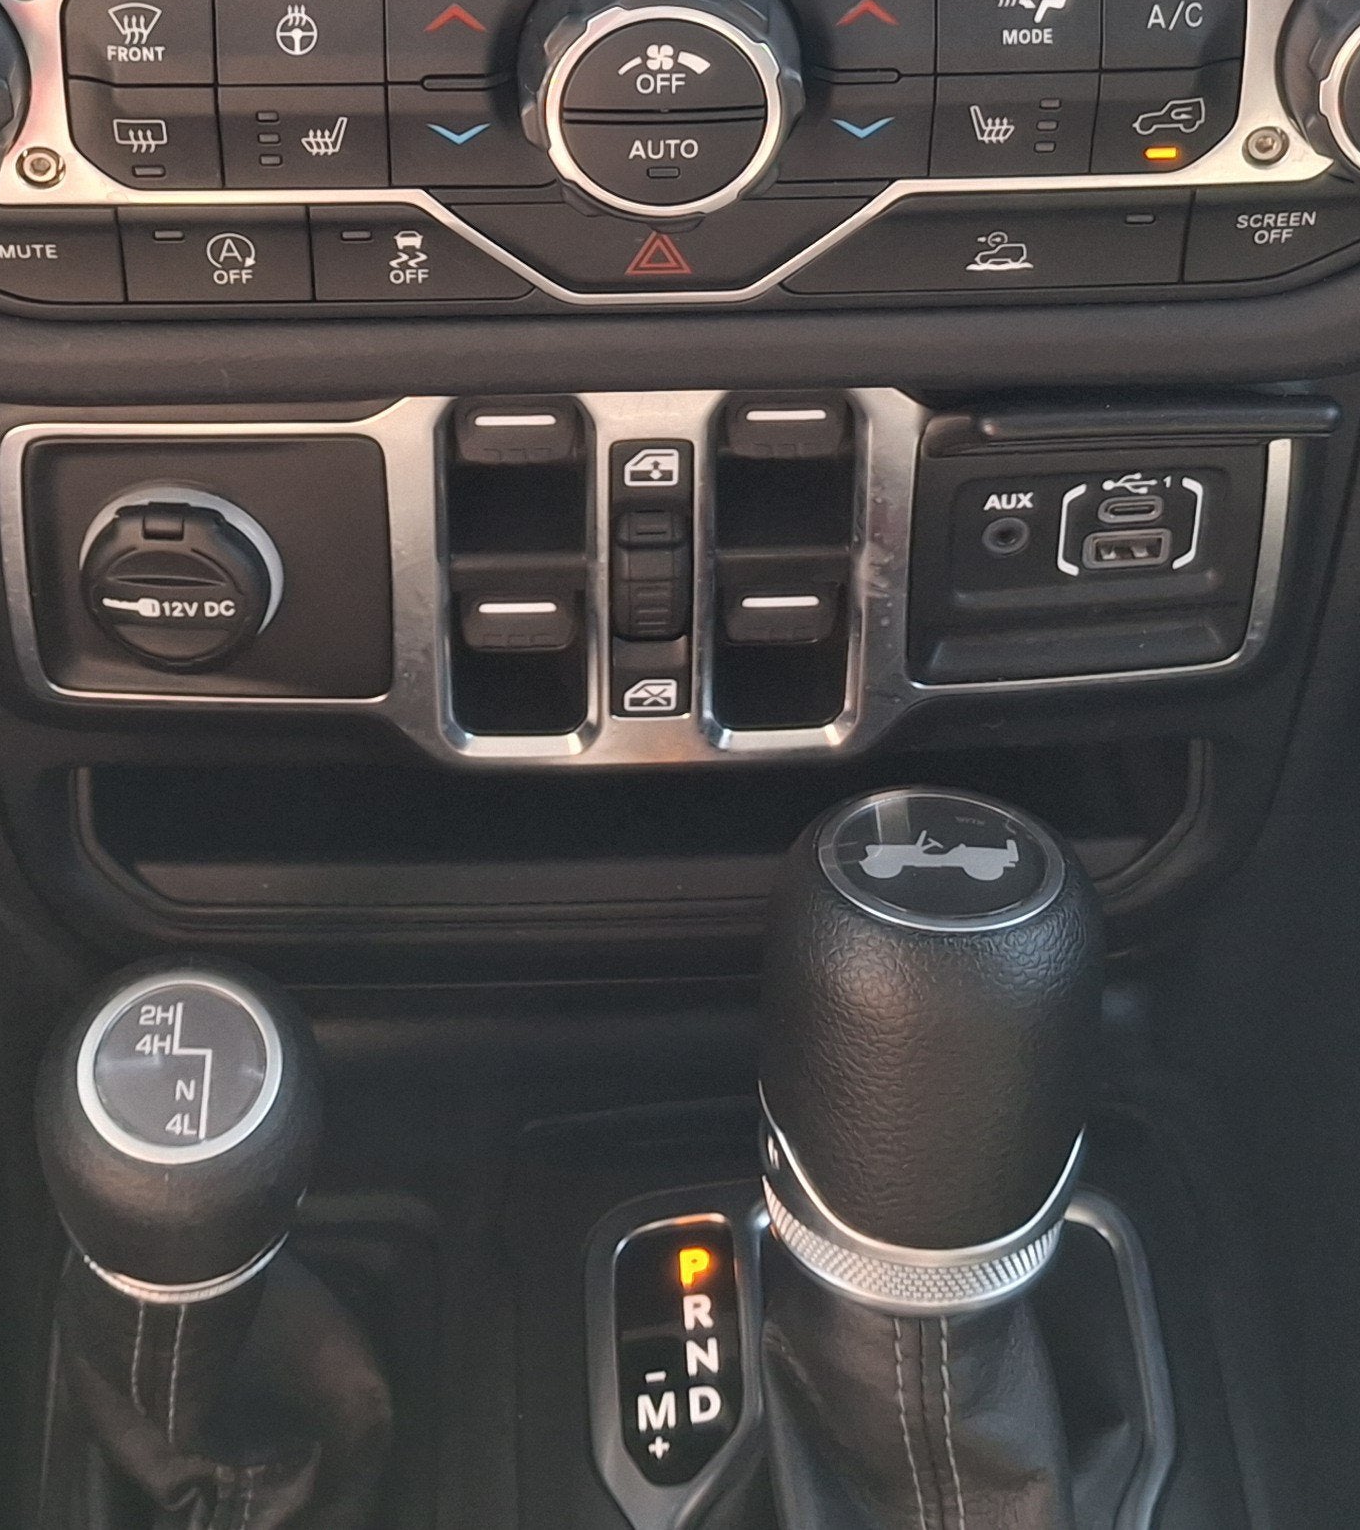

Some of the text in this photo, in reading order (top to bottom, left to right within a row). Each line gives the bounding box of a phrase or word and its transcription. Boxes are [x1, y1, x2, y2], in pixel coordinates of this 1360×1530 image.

[1147, 2, 1203, 29] A/C
[1002, 29, 1053, 45] MODE
[107, 45, 165, 63] FRONT
[636, 74, 686, 95] OFF
[628, 139, 699, 159] AUTO
[1237, 211, 1316, 228] SCREEN
[1254, 228, 1294, 245] OFF
[213, 270, 253, 286] OFF
[389, 269, 429, 285] OFF
[984, 492, 1033, 511] AUX
[162, 599, 236, 618] 12V DC
[139, 1005, 174, 1025] 2H
[136, 1034, 171, 1055] 4H
[175, 1080, 195, 1100] N
[166, 1113, 196, 1135] 4L
[679, 1247, 709, 1286] P
[683, 1294, 713, 1330] R
[686, 1337, 719, 1376] N
[638, 1391, 676, 1431] M
[689, 1386, 721, 1424] D
